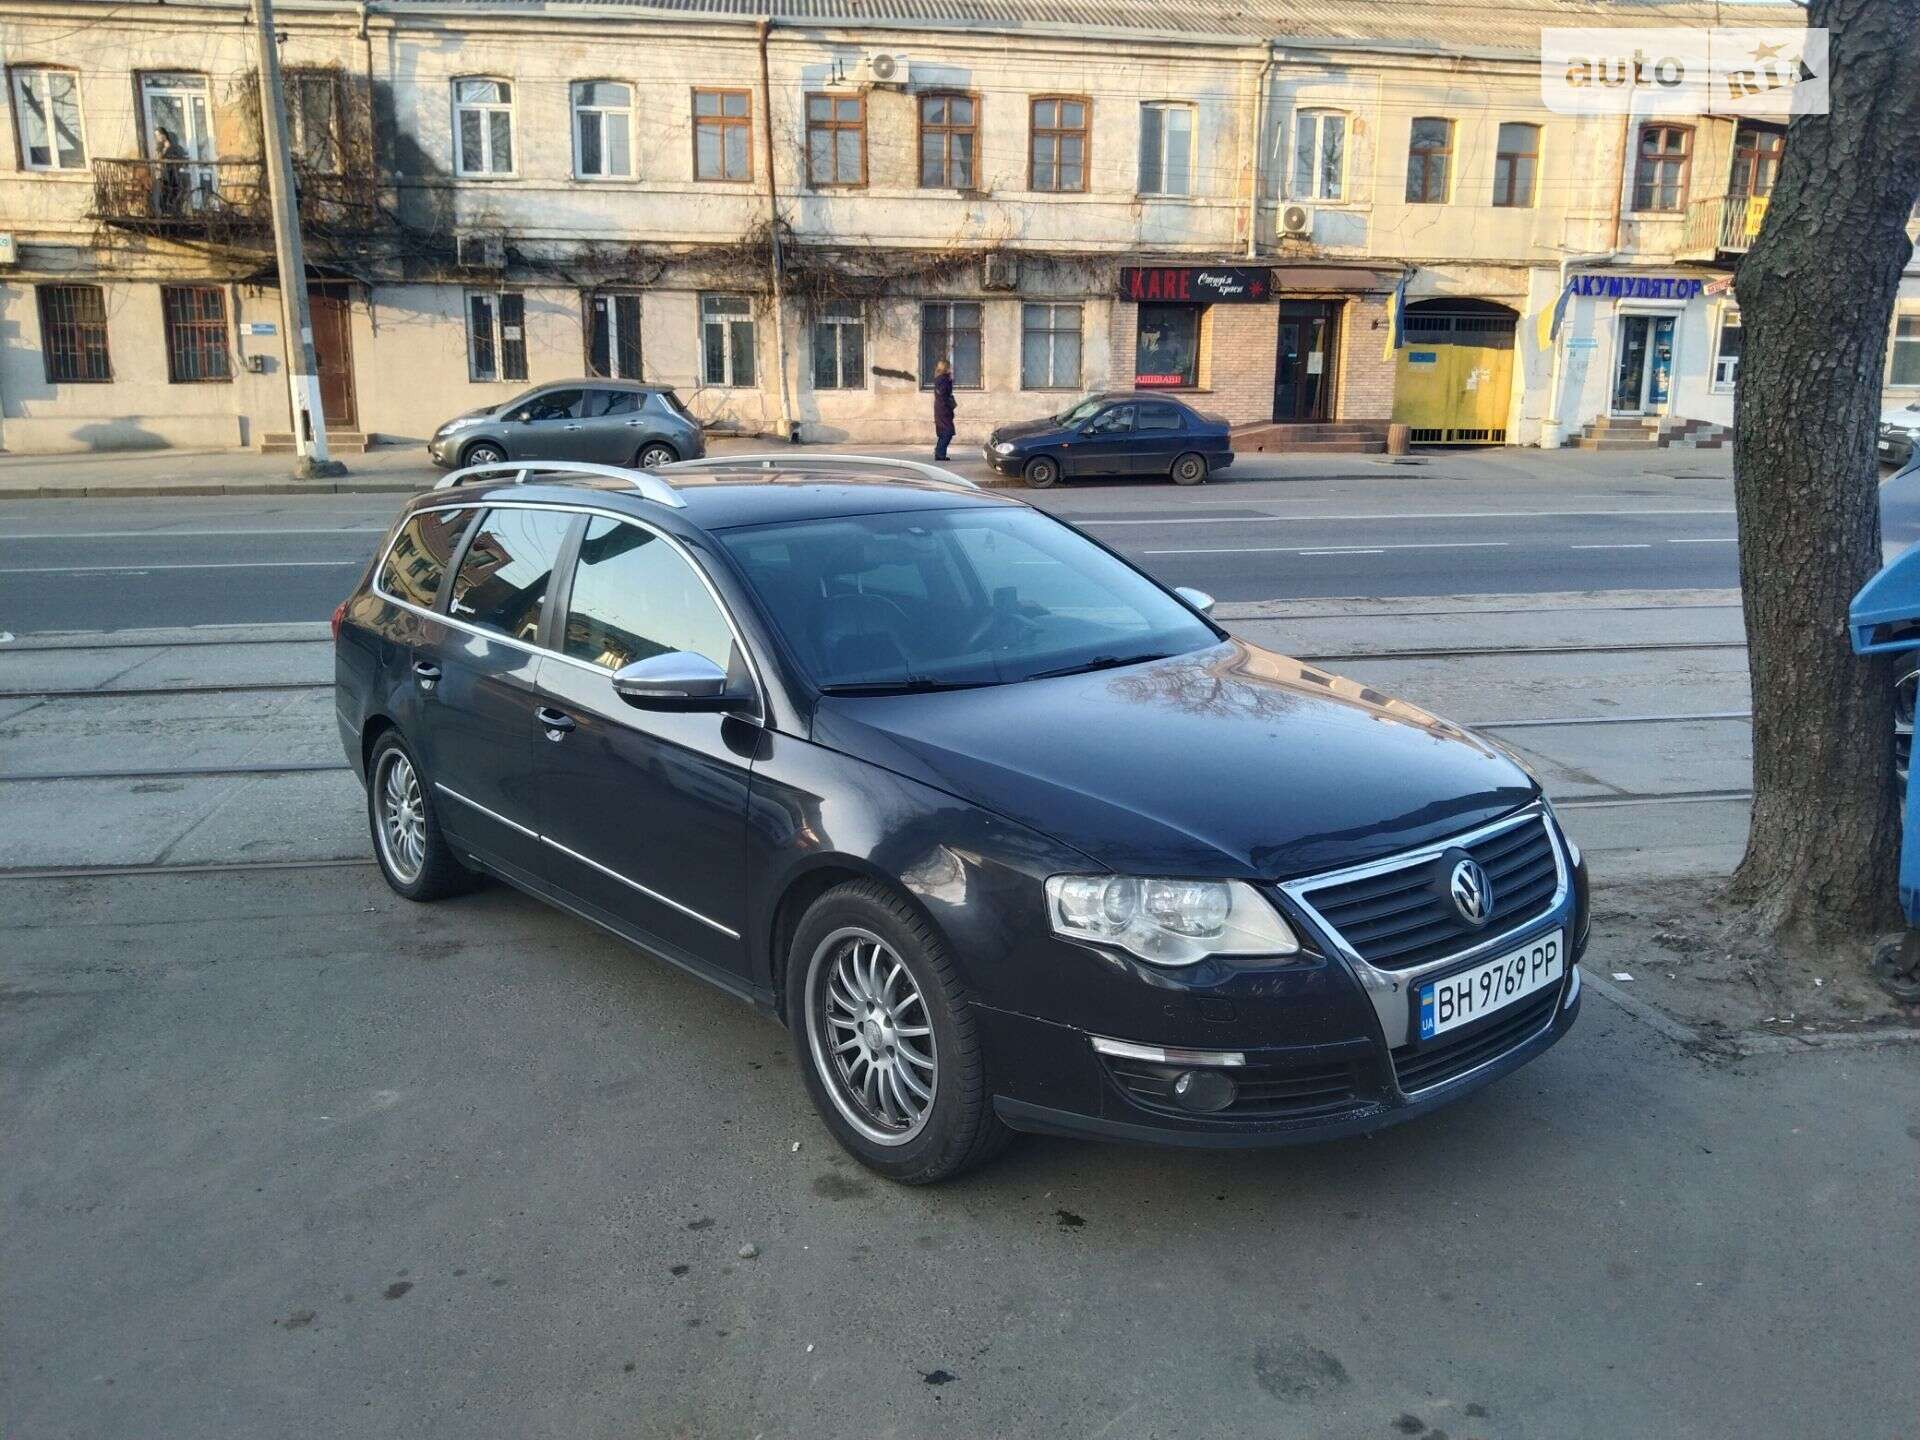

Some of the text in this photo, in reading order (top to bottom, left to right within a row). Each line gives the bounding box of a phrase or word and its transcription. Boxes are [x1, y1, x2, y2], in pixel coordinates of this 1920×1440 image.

[1131, 270, 1190, 299] KARE
[1570, 275, 1701, 299] АКУМУЛЯТОР
[1438, 940, 1557, 1024] BH 9769 PP
[1422, 1019, 1433, 1031] UA
